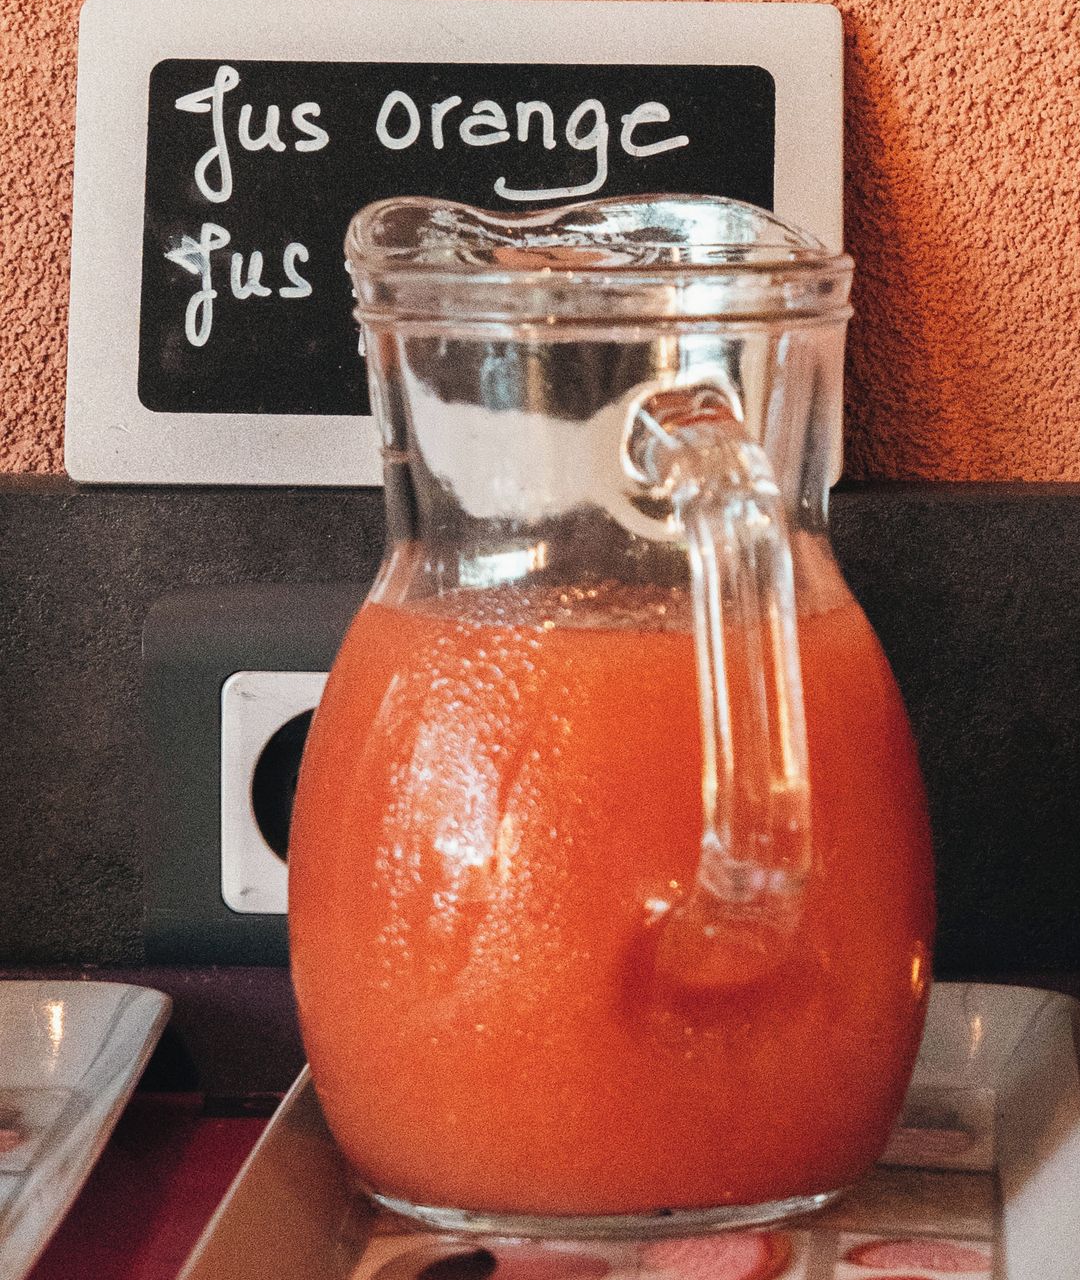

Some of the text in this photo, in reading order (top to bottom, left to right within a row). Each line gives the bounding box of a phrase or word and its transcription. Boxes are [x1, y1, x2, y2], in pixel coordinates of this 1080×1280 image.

[175, 64, 690, 204] Jus orange
[164, 222, 313, 347] Jus
